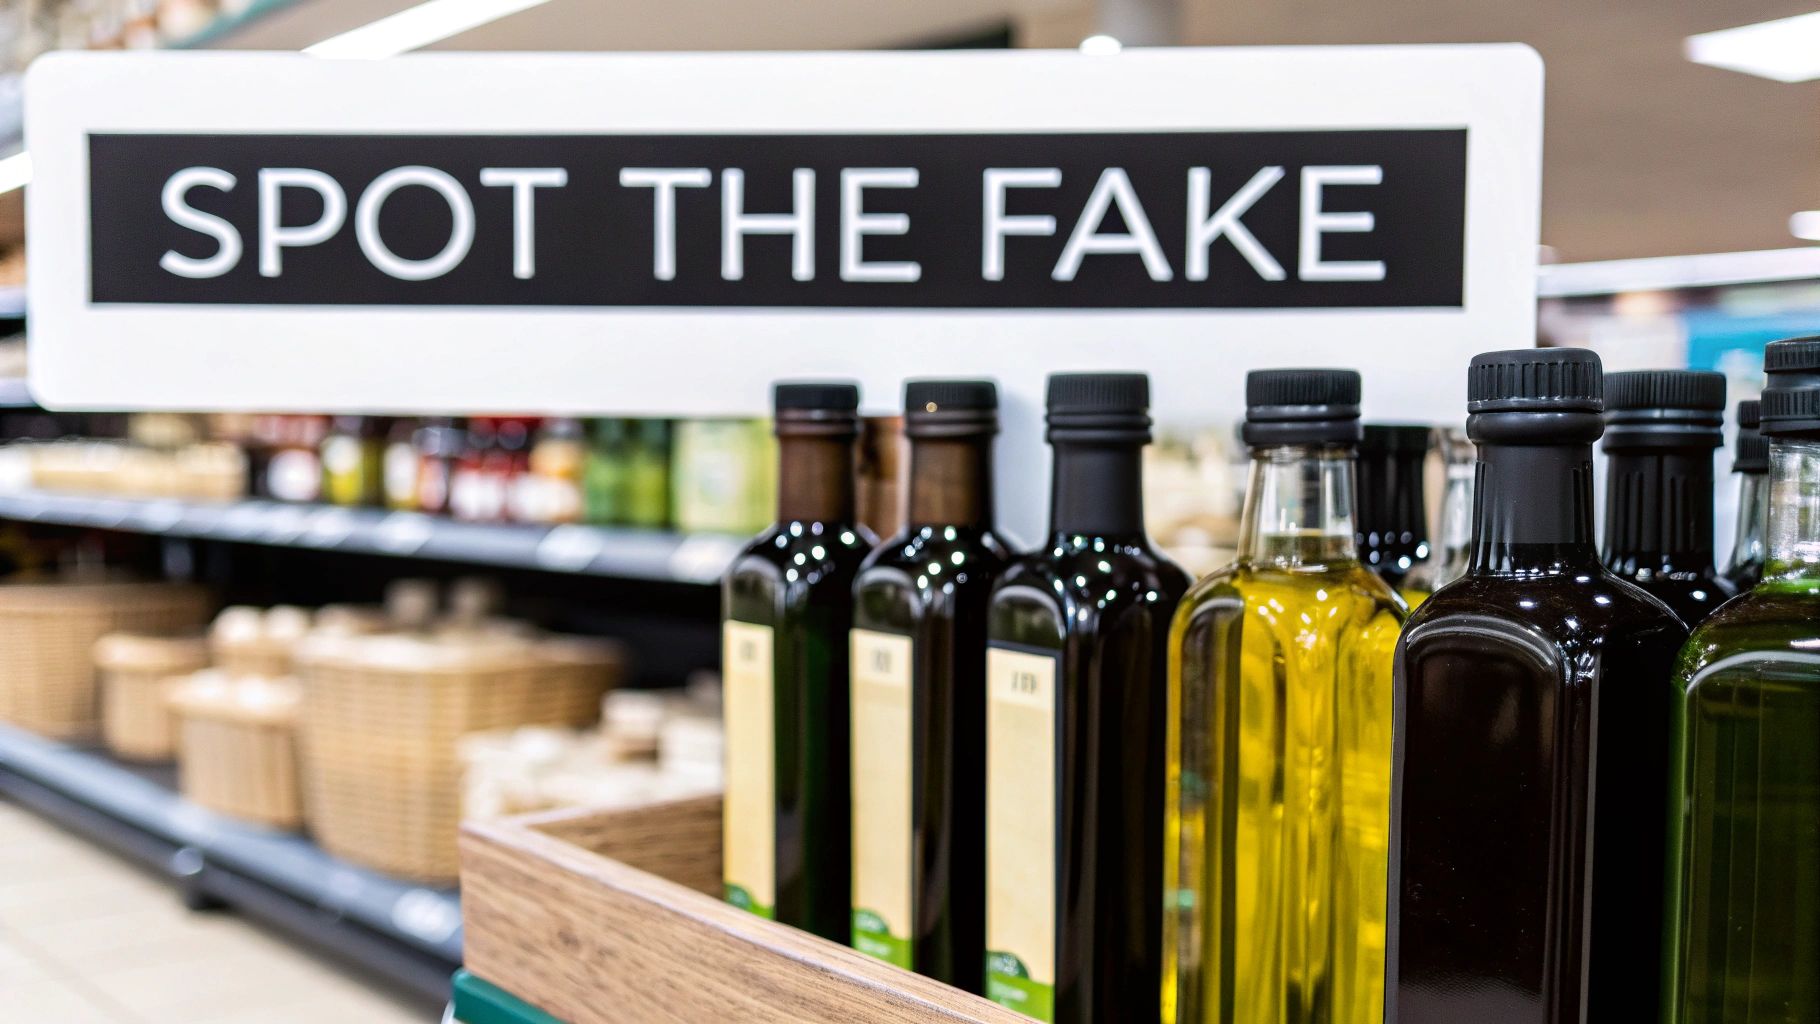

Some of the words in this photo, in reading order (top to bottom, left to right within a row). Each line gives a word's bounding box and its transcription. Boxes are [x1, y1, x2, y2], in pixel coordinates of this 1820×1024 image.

[160, 166, 568, 281] SPOT
[619, 167, 922, 283] THE
[982, 165, 1386, 282] FAKE
